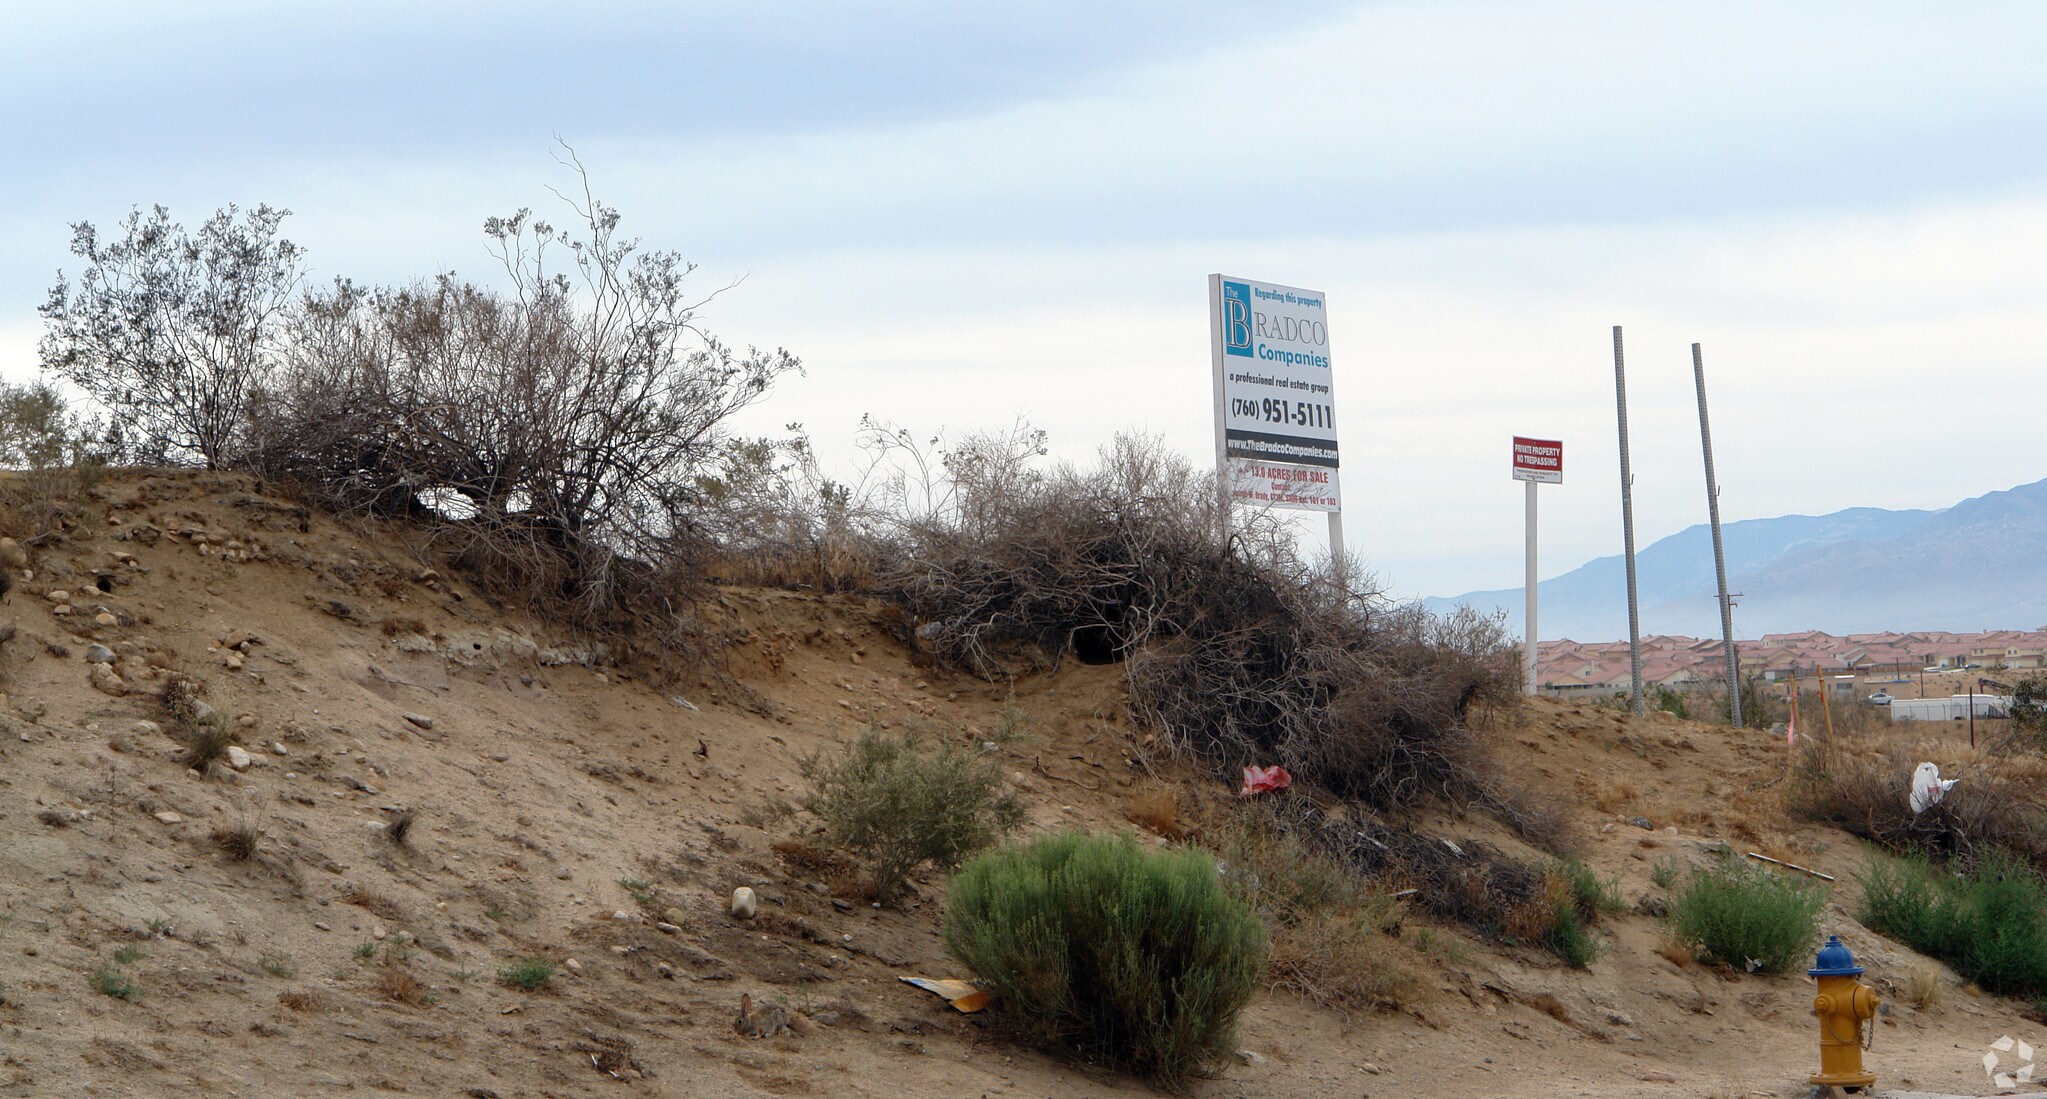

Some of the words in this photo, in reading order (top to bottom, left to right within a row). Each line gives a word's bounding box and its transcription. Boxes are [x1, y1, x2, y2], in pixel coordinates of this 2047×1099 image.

[1225, 286, 1239, 298] The
[1254, 287, 1285, 304] Regarding
[1285, 292, 1297, 304] this
[1297, 295, 1322, 310] property
[1258, 343, 1328, 368] Companies
[1229, 373, 1234, 381] a
[1235, 372, 1275, 387] professional
[1275, 377, 1289, 389] real
[1289, 380, 1310, 391] estate
[1310, 383, 1329, 395] group
[1231, 397, 1260, 421] (760)
[1262, 397, 1332, 430] 951-5111
[1227, 439, 1337, 459] www.TheBradcoCompanies.com
[1515, 443, 1532, 454] PRIVATE
[1532, 446, 1560, 456] PROPERTY
[1516, 454, 1524, 463] NO
[1524, 455, 1557, 466] TRESPASSING
[1267, 466, 1291, 481] ACRES
[1293, 469, 1308, 482] FOR
[1309, 471, 1329, 484] SALE
